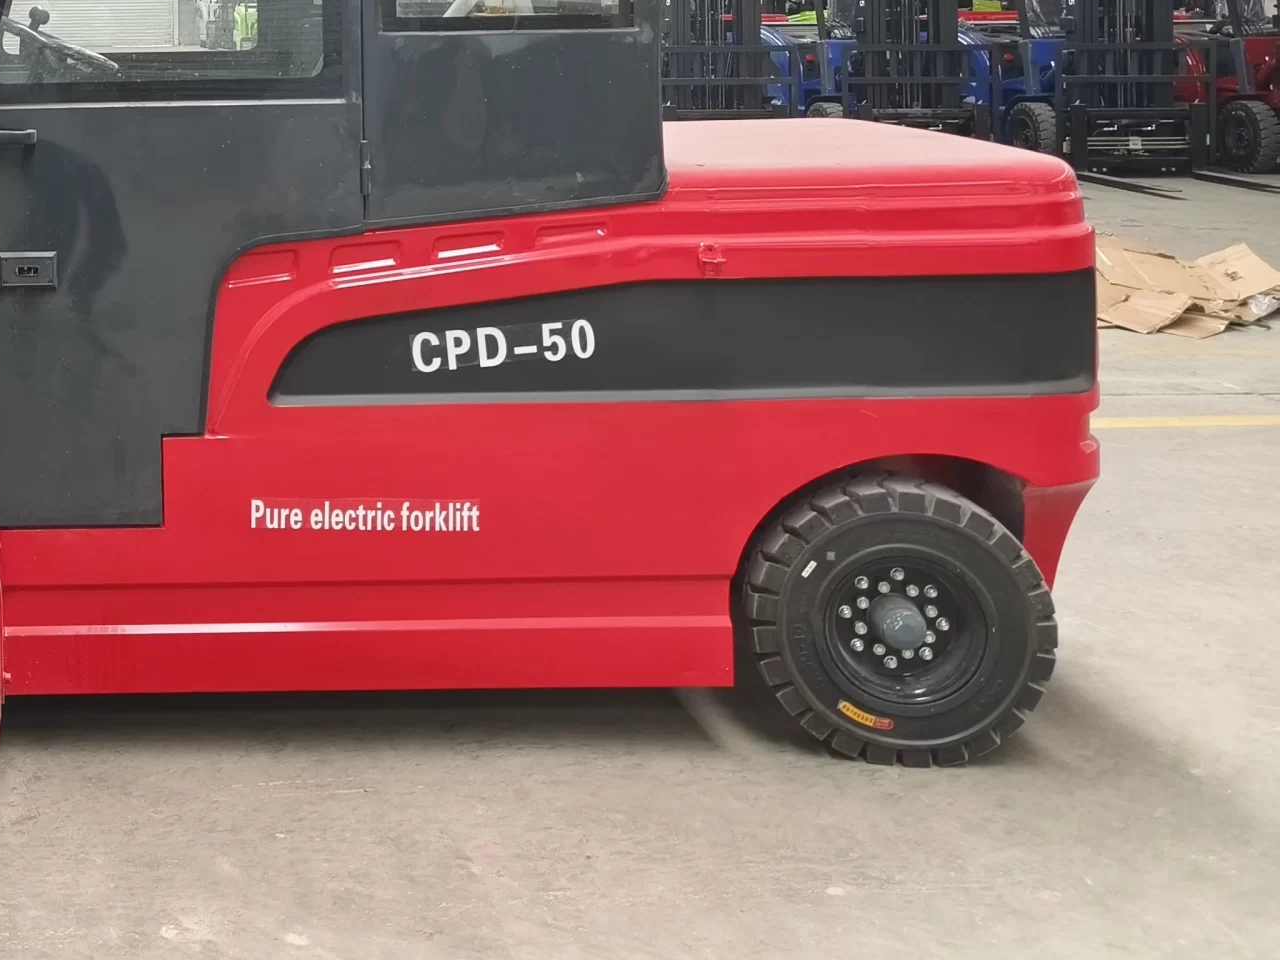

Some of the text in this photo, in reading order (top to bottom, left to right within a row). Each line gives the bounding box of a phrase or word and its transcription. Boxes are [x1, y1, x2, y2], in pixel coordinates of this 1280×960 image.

[411, 318, 596, 373] CPD-50
[250, 499, 480, 532] Pure electric forklift
